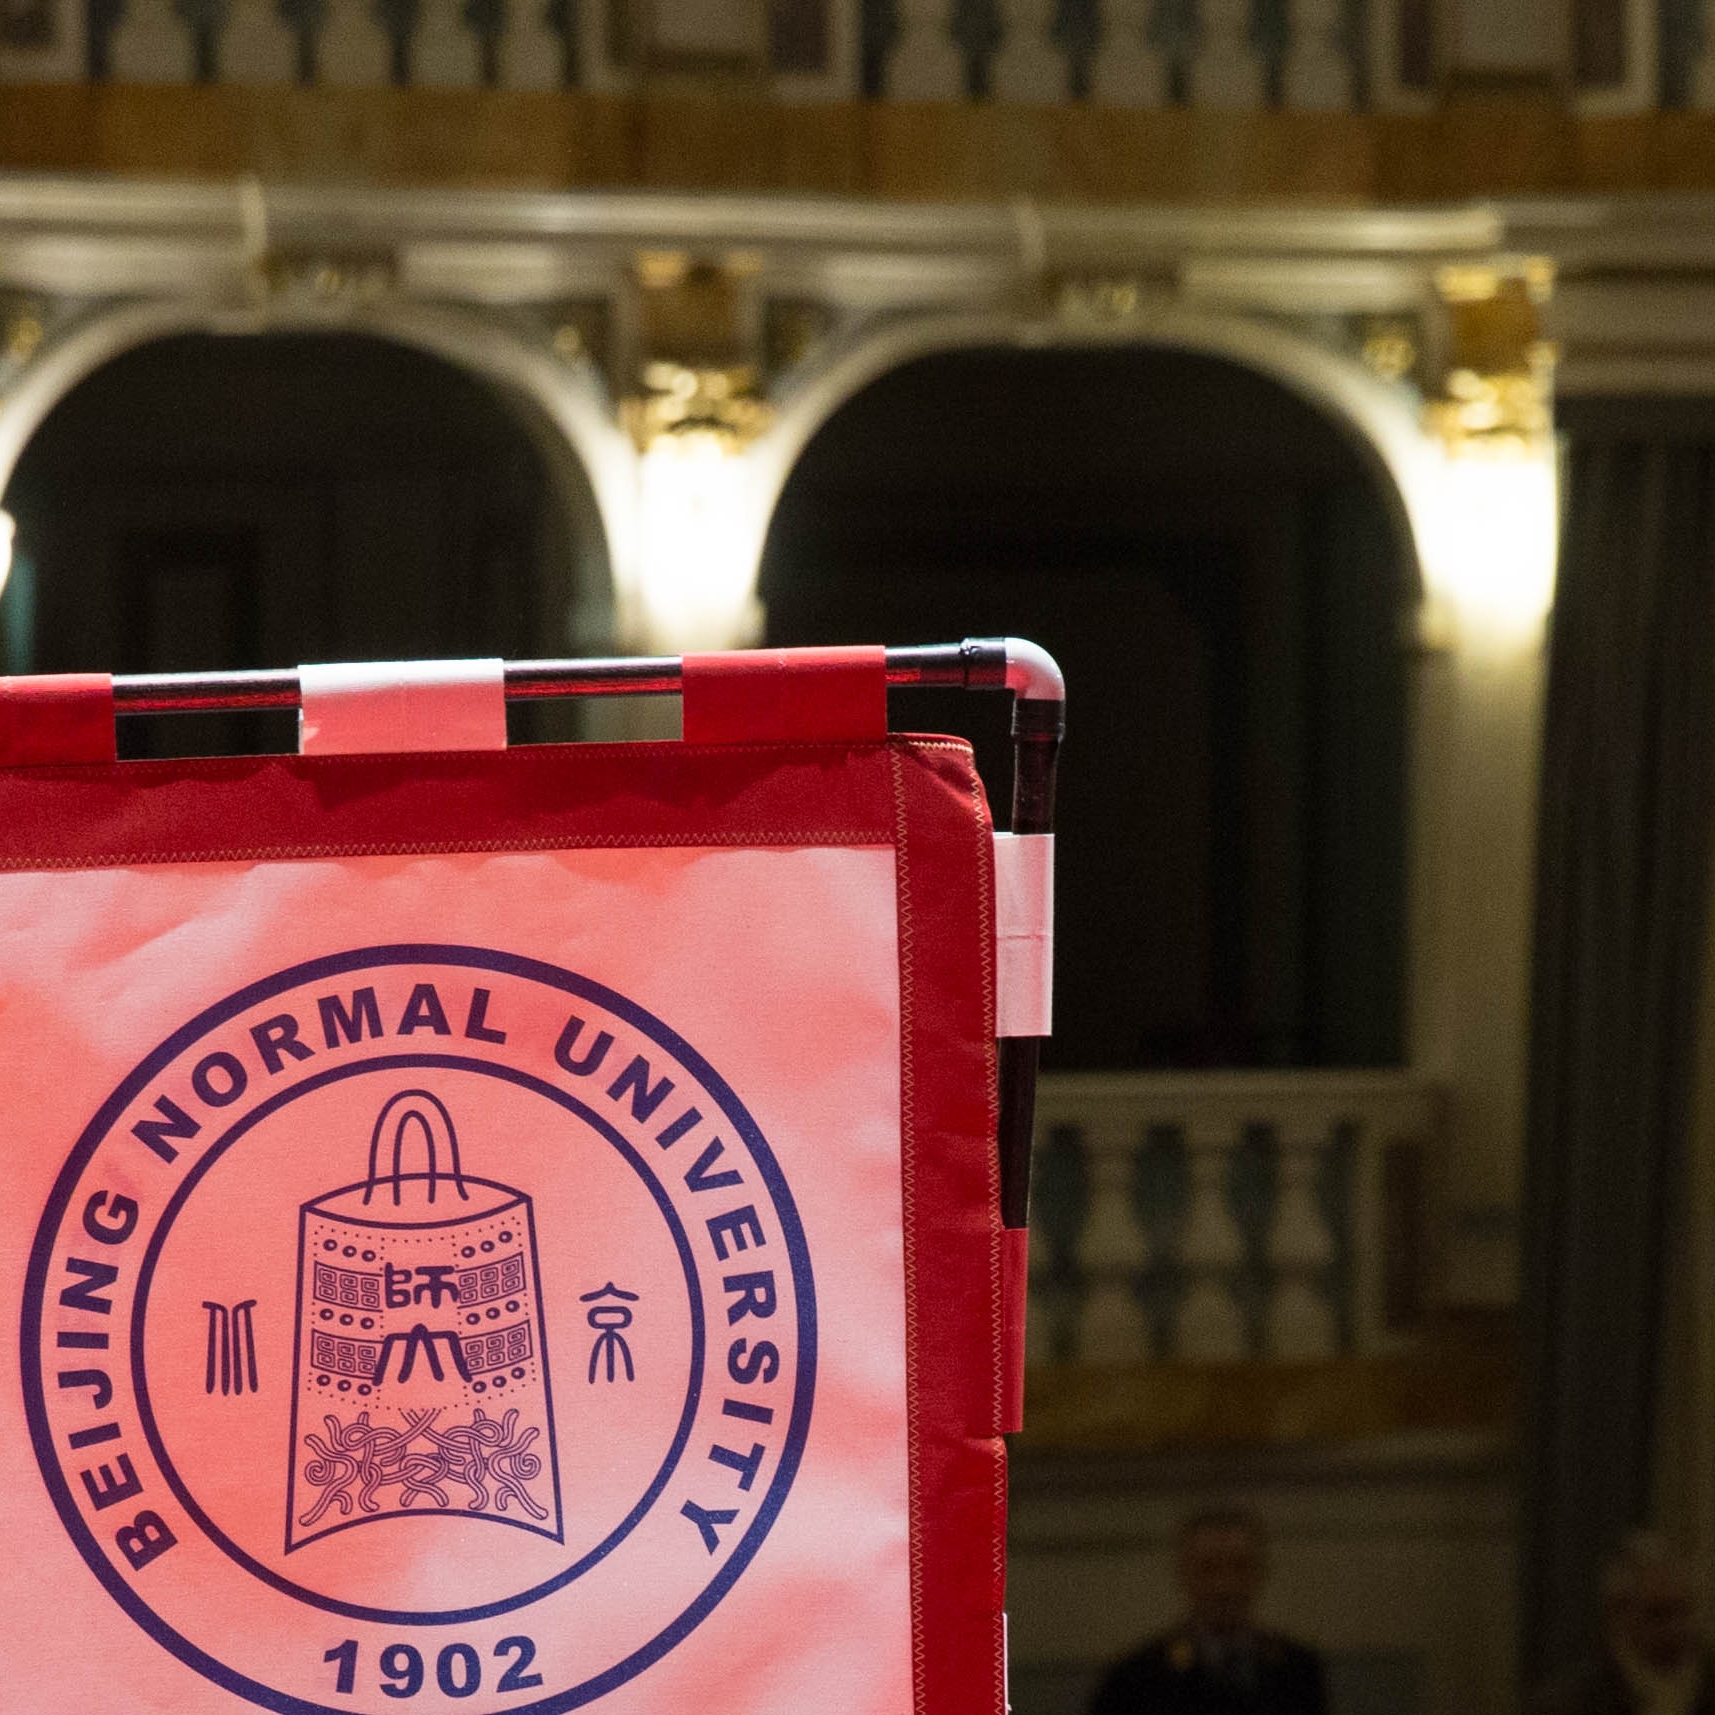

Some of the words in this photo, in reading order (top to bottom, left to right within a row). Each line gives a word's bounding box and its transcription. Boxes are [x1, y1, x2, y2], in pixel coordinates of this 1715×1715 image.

[55, 1190, 180, 1573] BEIJING
[129, 982, 508, 1165] NORMAL
[553, 1014, 781, 1557] UNIVERSITY
[322, 1634, 545, 1700] 1902
